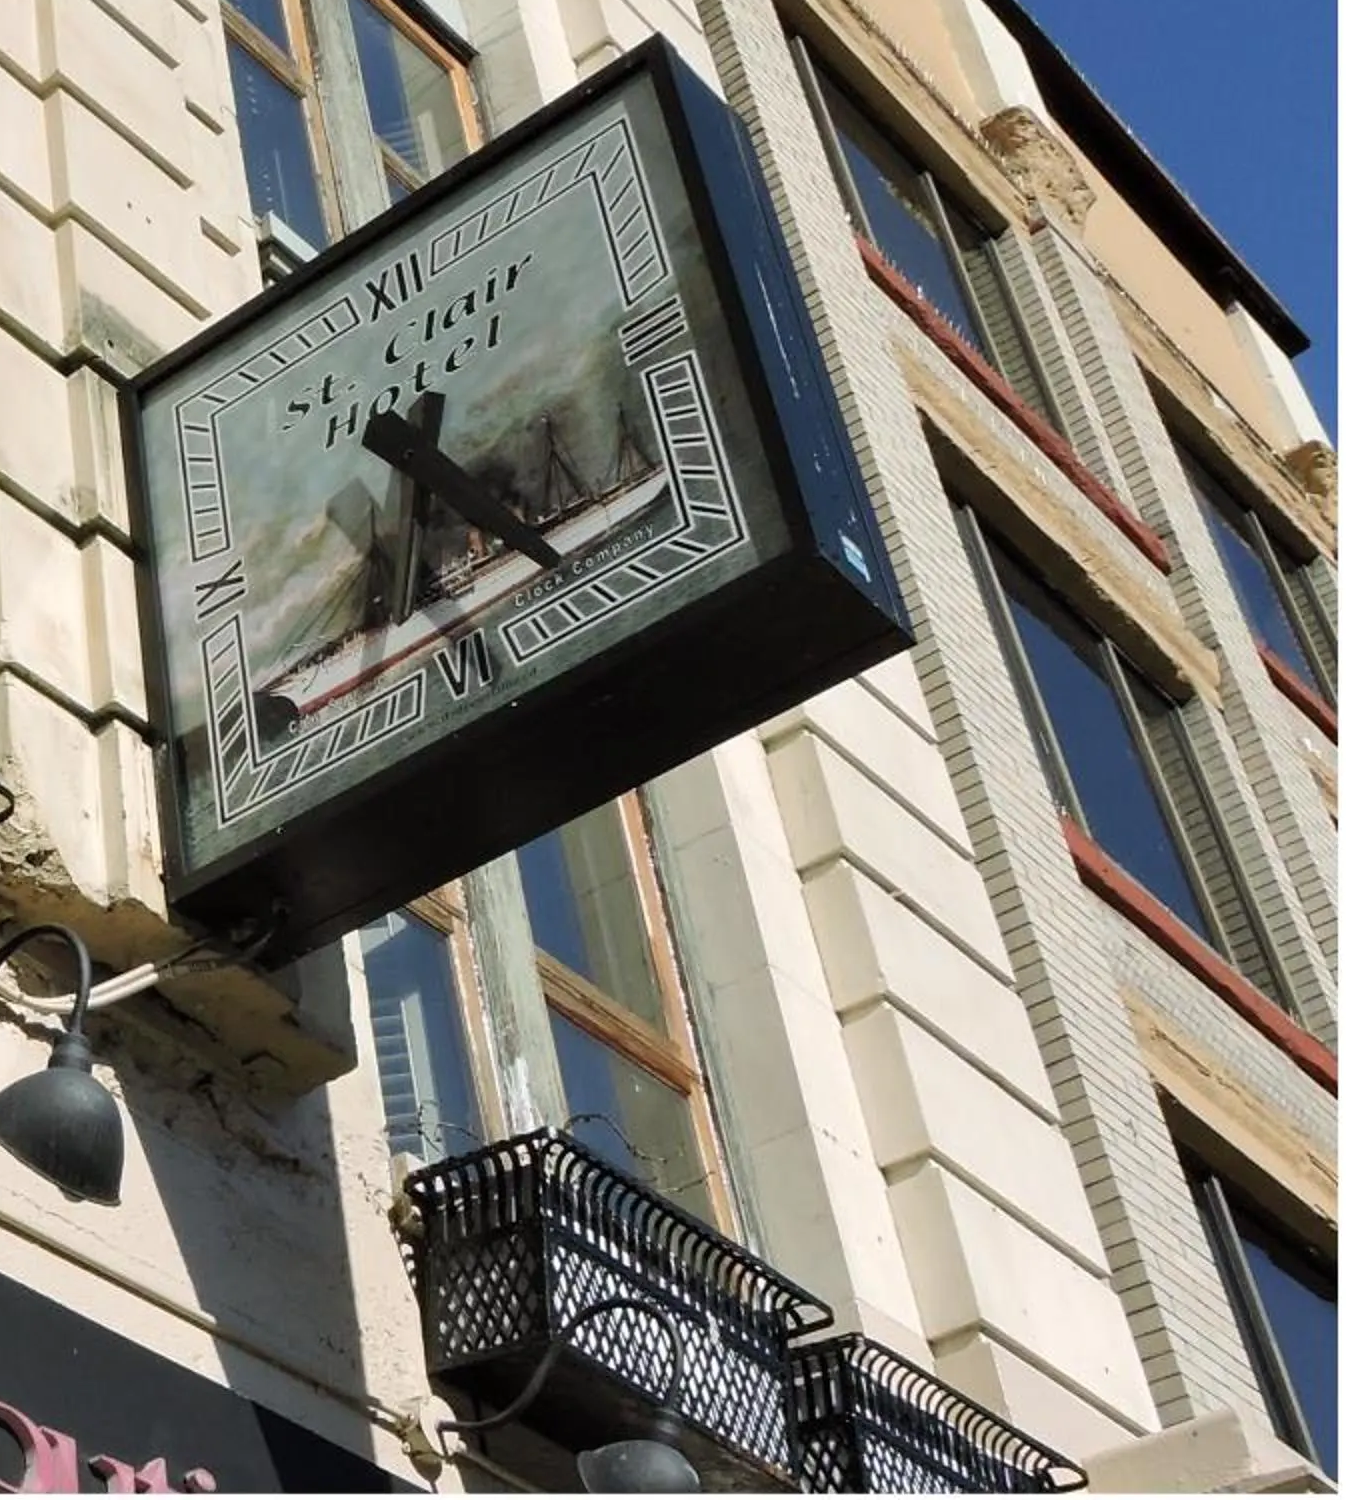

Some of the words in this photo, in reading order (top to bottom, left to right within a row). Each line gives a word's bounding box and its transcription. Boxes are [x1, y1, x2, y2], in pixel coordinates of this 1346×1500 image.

[363, 251, 424, 323] XII
[281, 372, 357, 432] St.
[384, 252, 533, 365] Clair
[323, 313, 501, 450] Hotel
[513, 574, 567, 607] Clock
[570, 522, 656, 576] Company
[432, 627, 493, 701] VI
